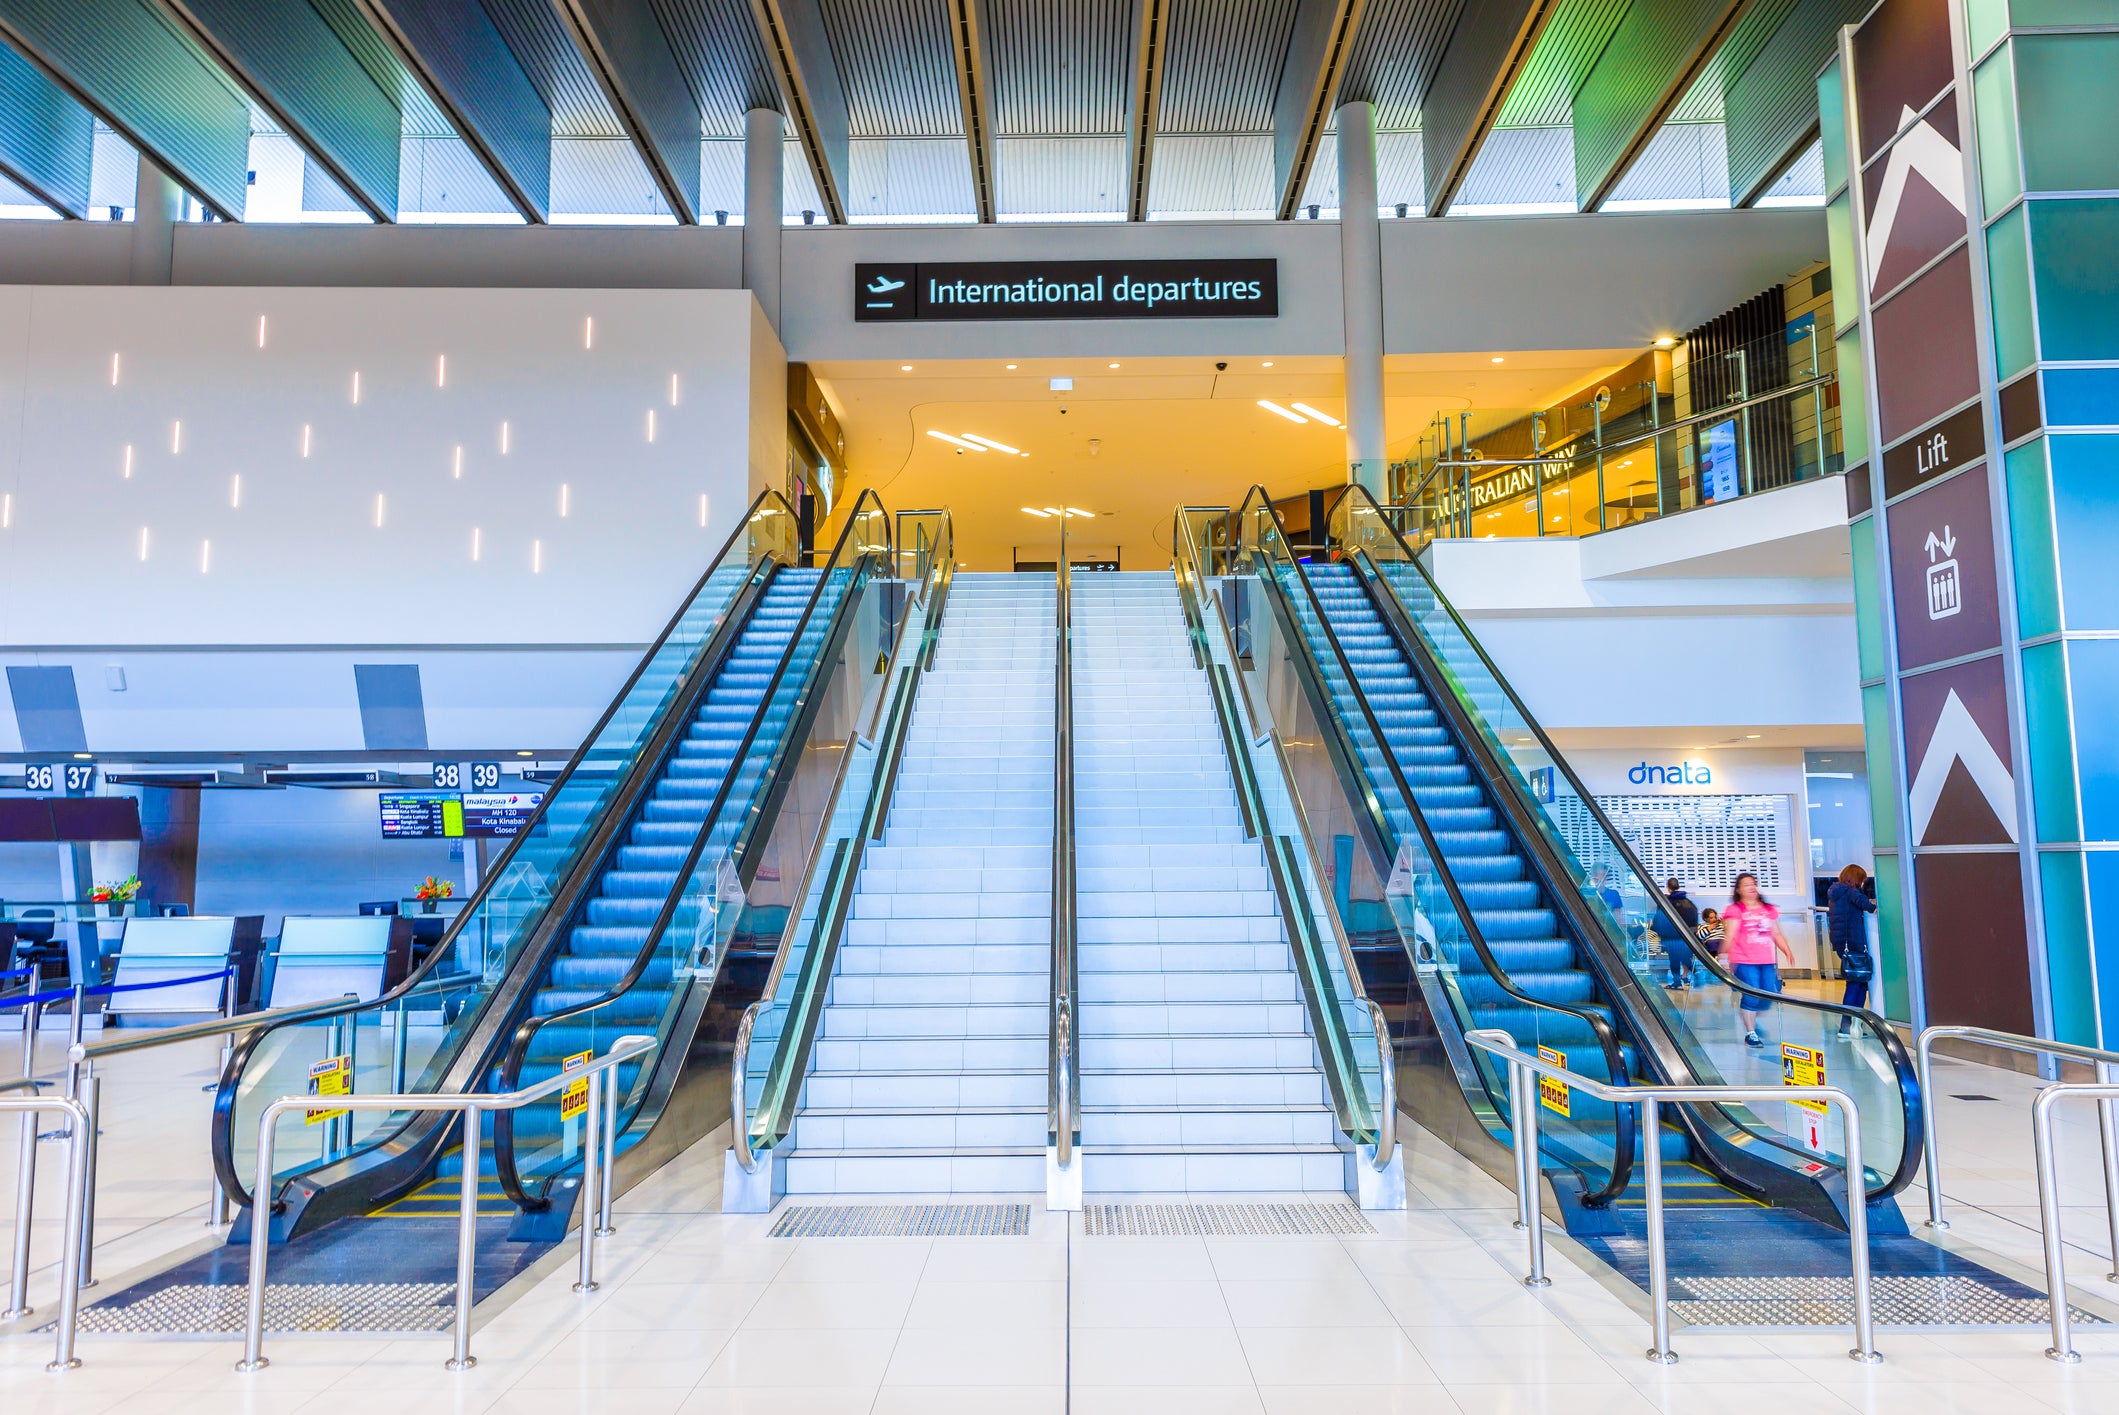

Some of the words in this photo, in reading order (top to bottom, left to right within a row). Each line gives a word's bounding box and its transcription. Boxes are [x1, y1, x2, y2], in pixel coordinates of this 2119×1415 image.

[929, 275, 1103, 304] International
[1112, 275, 1262, 308] departures
[1542, 444, 1578, 479] WAY
[1917, 432, 1949, 474] Lift
[26, 766, 52, 789] 36
[67, 766, 92, 790] 37
[434, 765, 459, 787] 38
[473, 765, 498, 787] 39
[1628, 761, 1711, 785] dnata
[466, 798, 506, 806] malaysia
[566, 1057, 583, 1068] WARNING
[1541, 1050, 1557, 1061] WARNING
[1785, 1047, 1809, 1059] WARNING
[313, 1062, 337, 1073] WARNING
